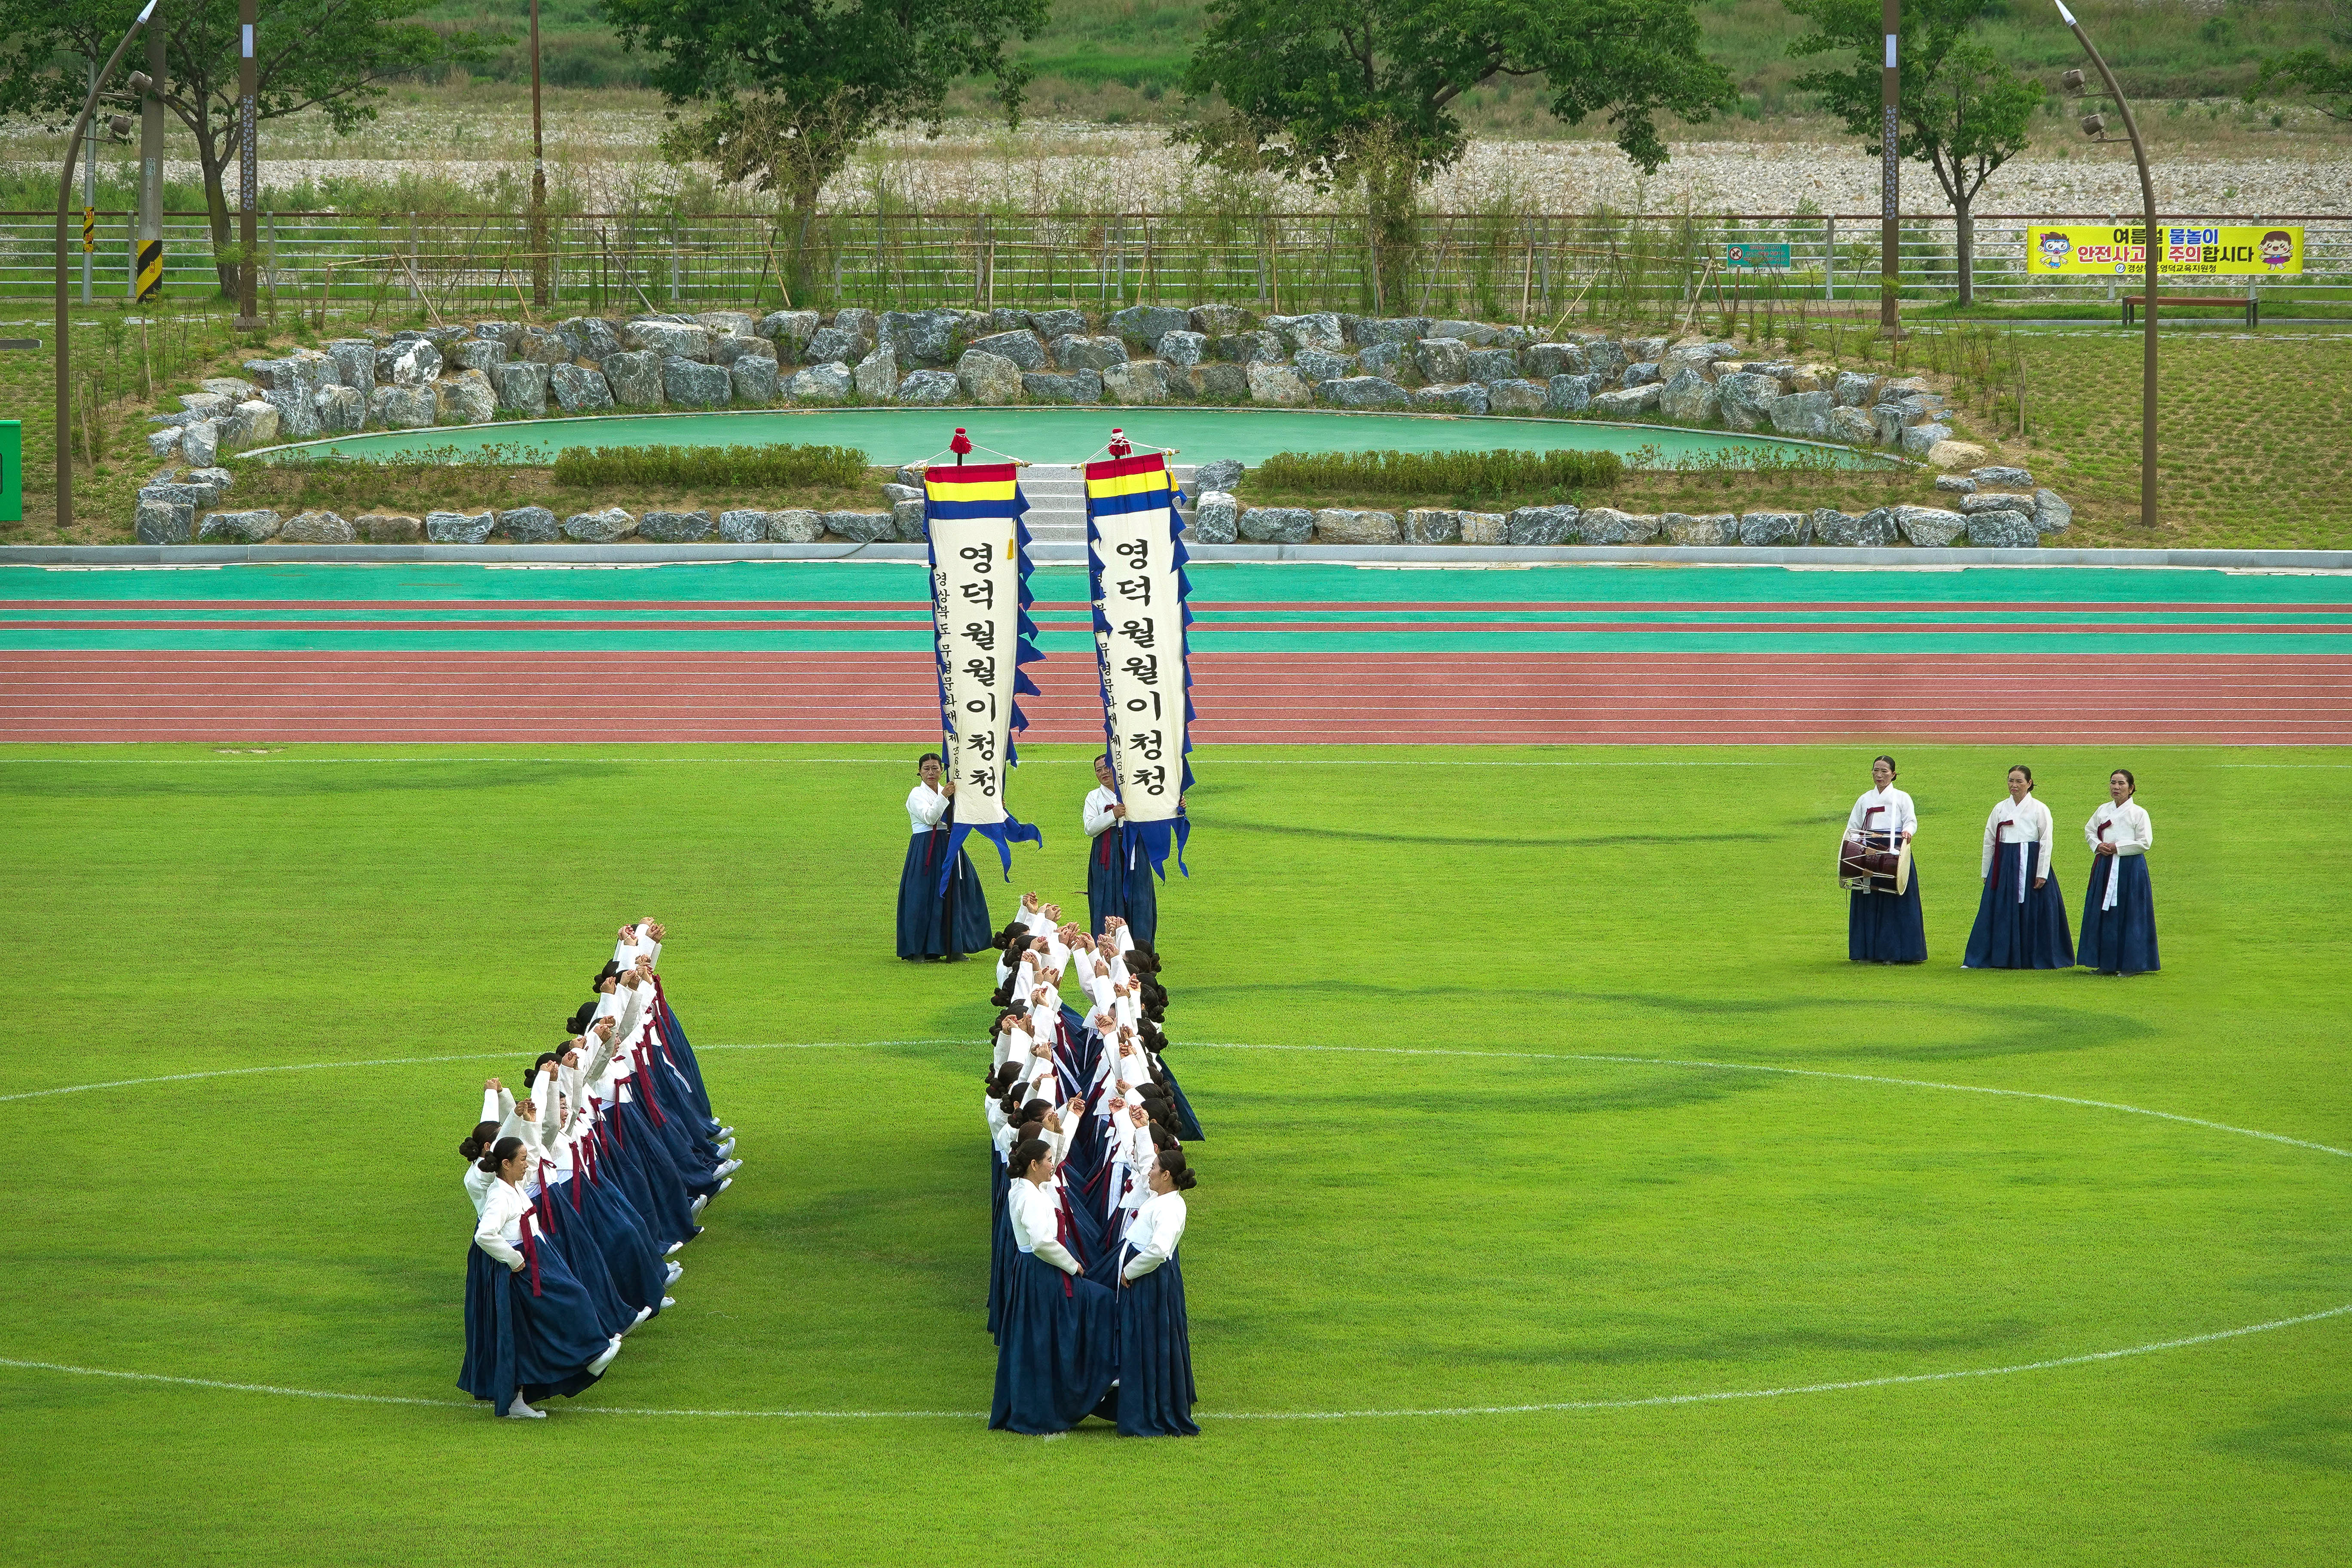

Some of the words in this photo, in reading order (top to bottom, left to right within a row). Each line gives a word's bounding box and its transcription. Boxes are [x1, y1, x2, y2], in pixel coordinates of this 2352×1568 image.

[2168, 246, 2254, 263] 주의합시다
[2169, 229, 2218, 245] 물놀이
[936, 572, 951, 635] 경상북도
[940, 644, 957, 724] 무형문화재
